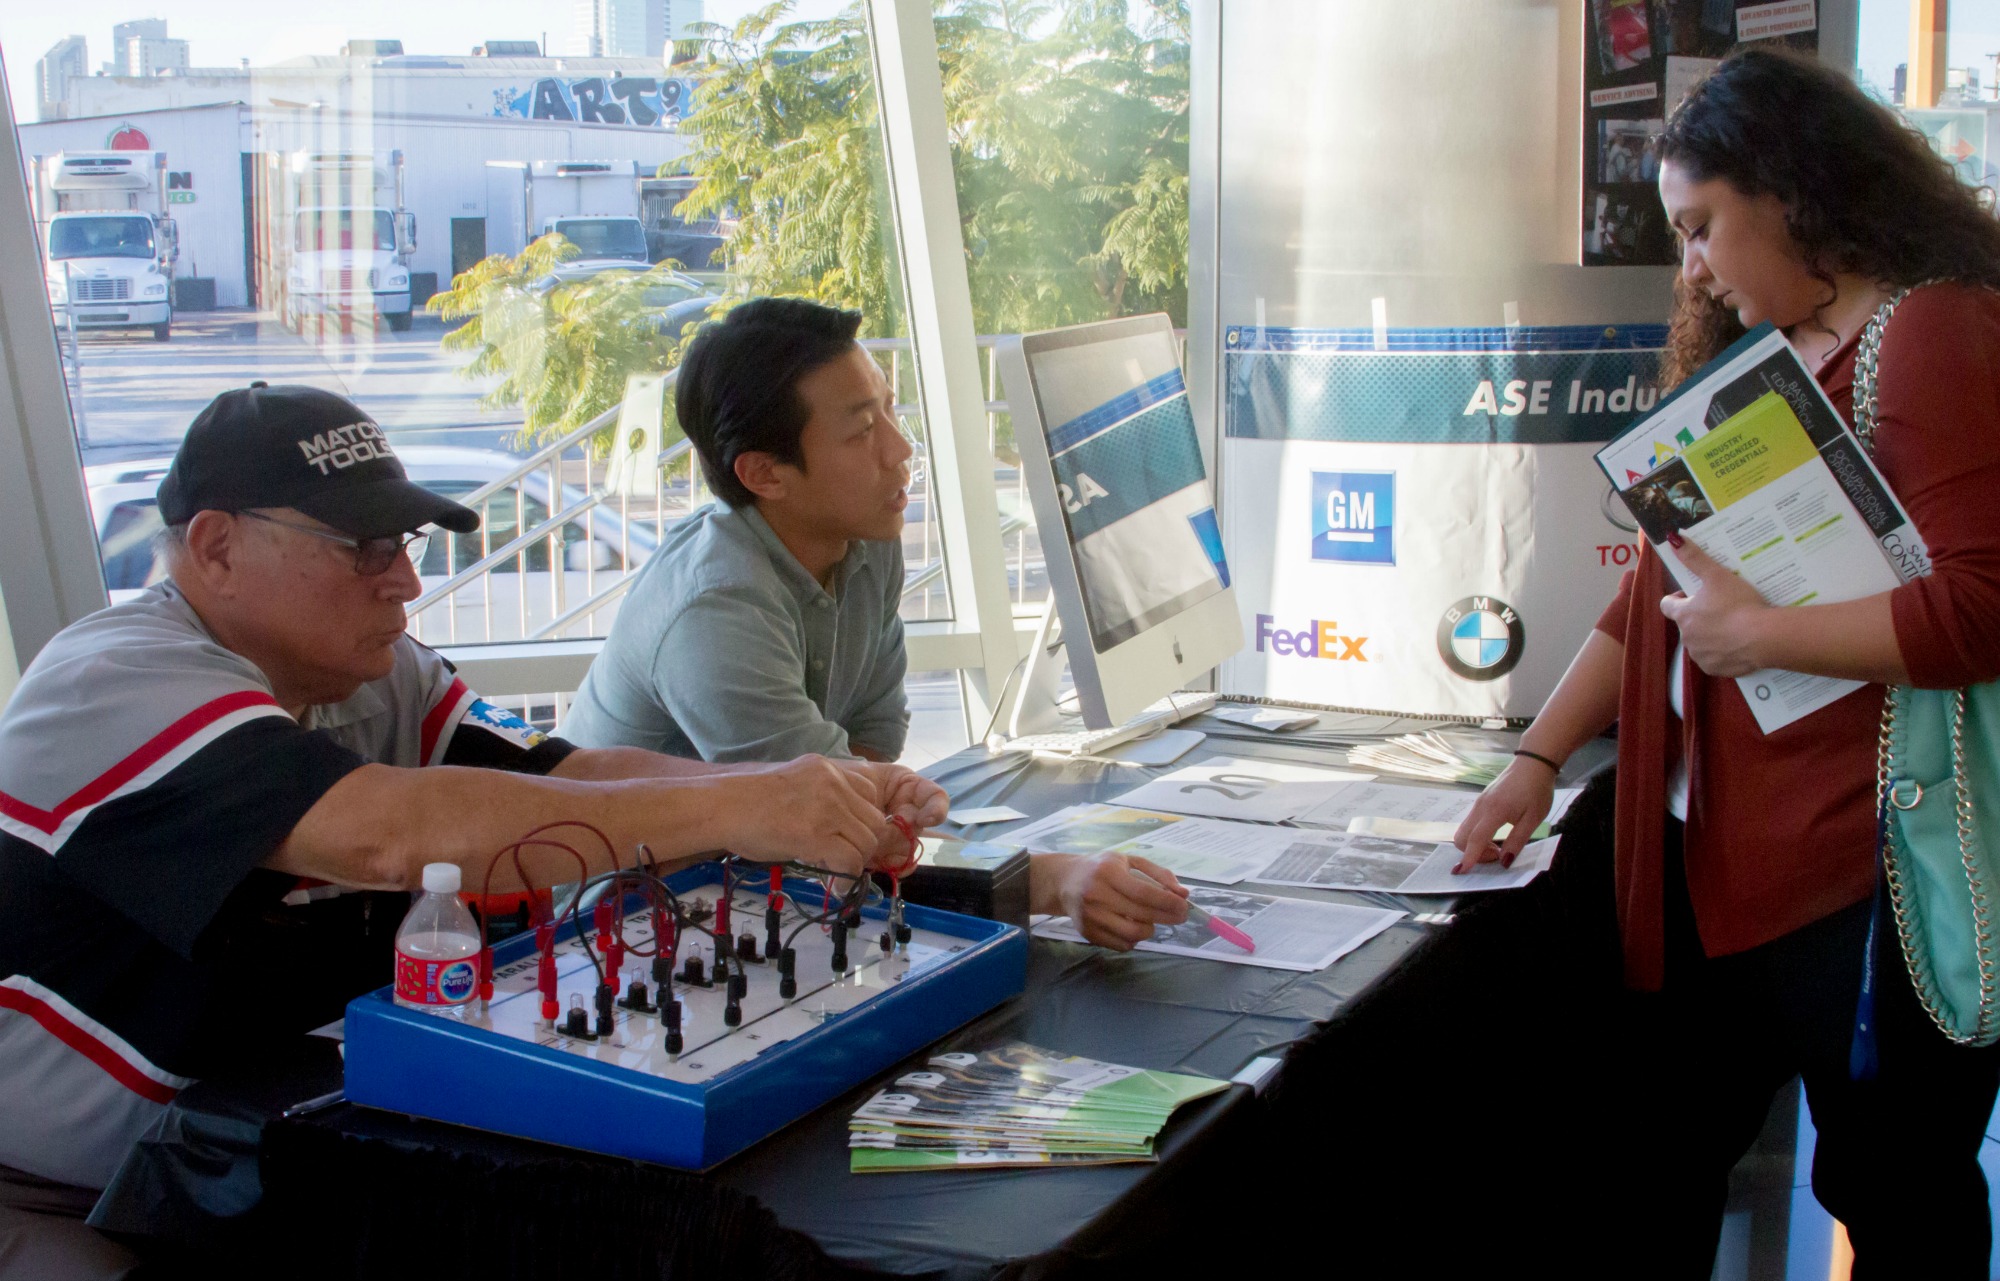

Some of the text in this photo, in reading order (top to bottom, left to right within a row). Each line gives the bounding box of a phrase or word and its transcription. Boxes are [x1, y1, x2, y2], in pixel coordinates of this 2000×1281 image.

[1463, 379, 1553, 416] ASE
[1567, 375, 1673, 415] Indu
[1770, 371, 1815, 431] EDUCATION
[1788, 381, 1813, 410] BASIC
[308, 440, 395, 476] TOOLS
[1704, 433, 1744, 460] INDUSTRY
[1709, 437, 1760, 470] RECOGNIZED
[1714, 444, 1769, 479] CREDENTIALS
[1826, 453, 1886, 531] OPPORTUNITIES
[1835, 449, 1890, 522] OCCUPATIONAL
[1327, 490, 1375, 530] GM
[1445, 597, 1516, 624] BMW
[1256, 613, 1369, 662] FedEx
